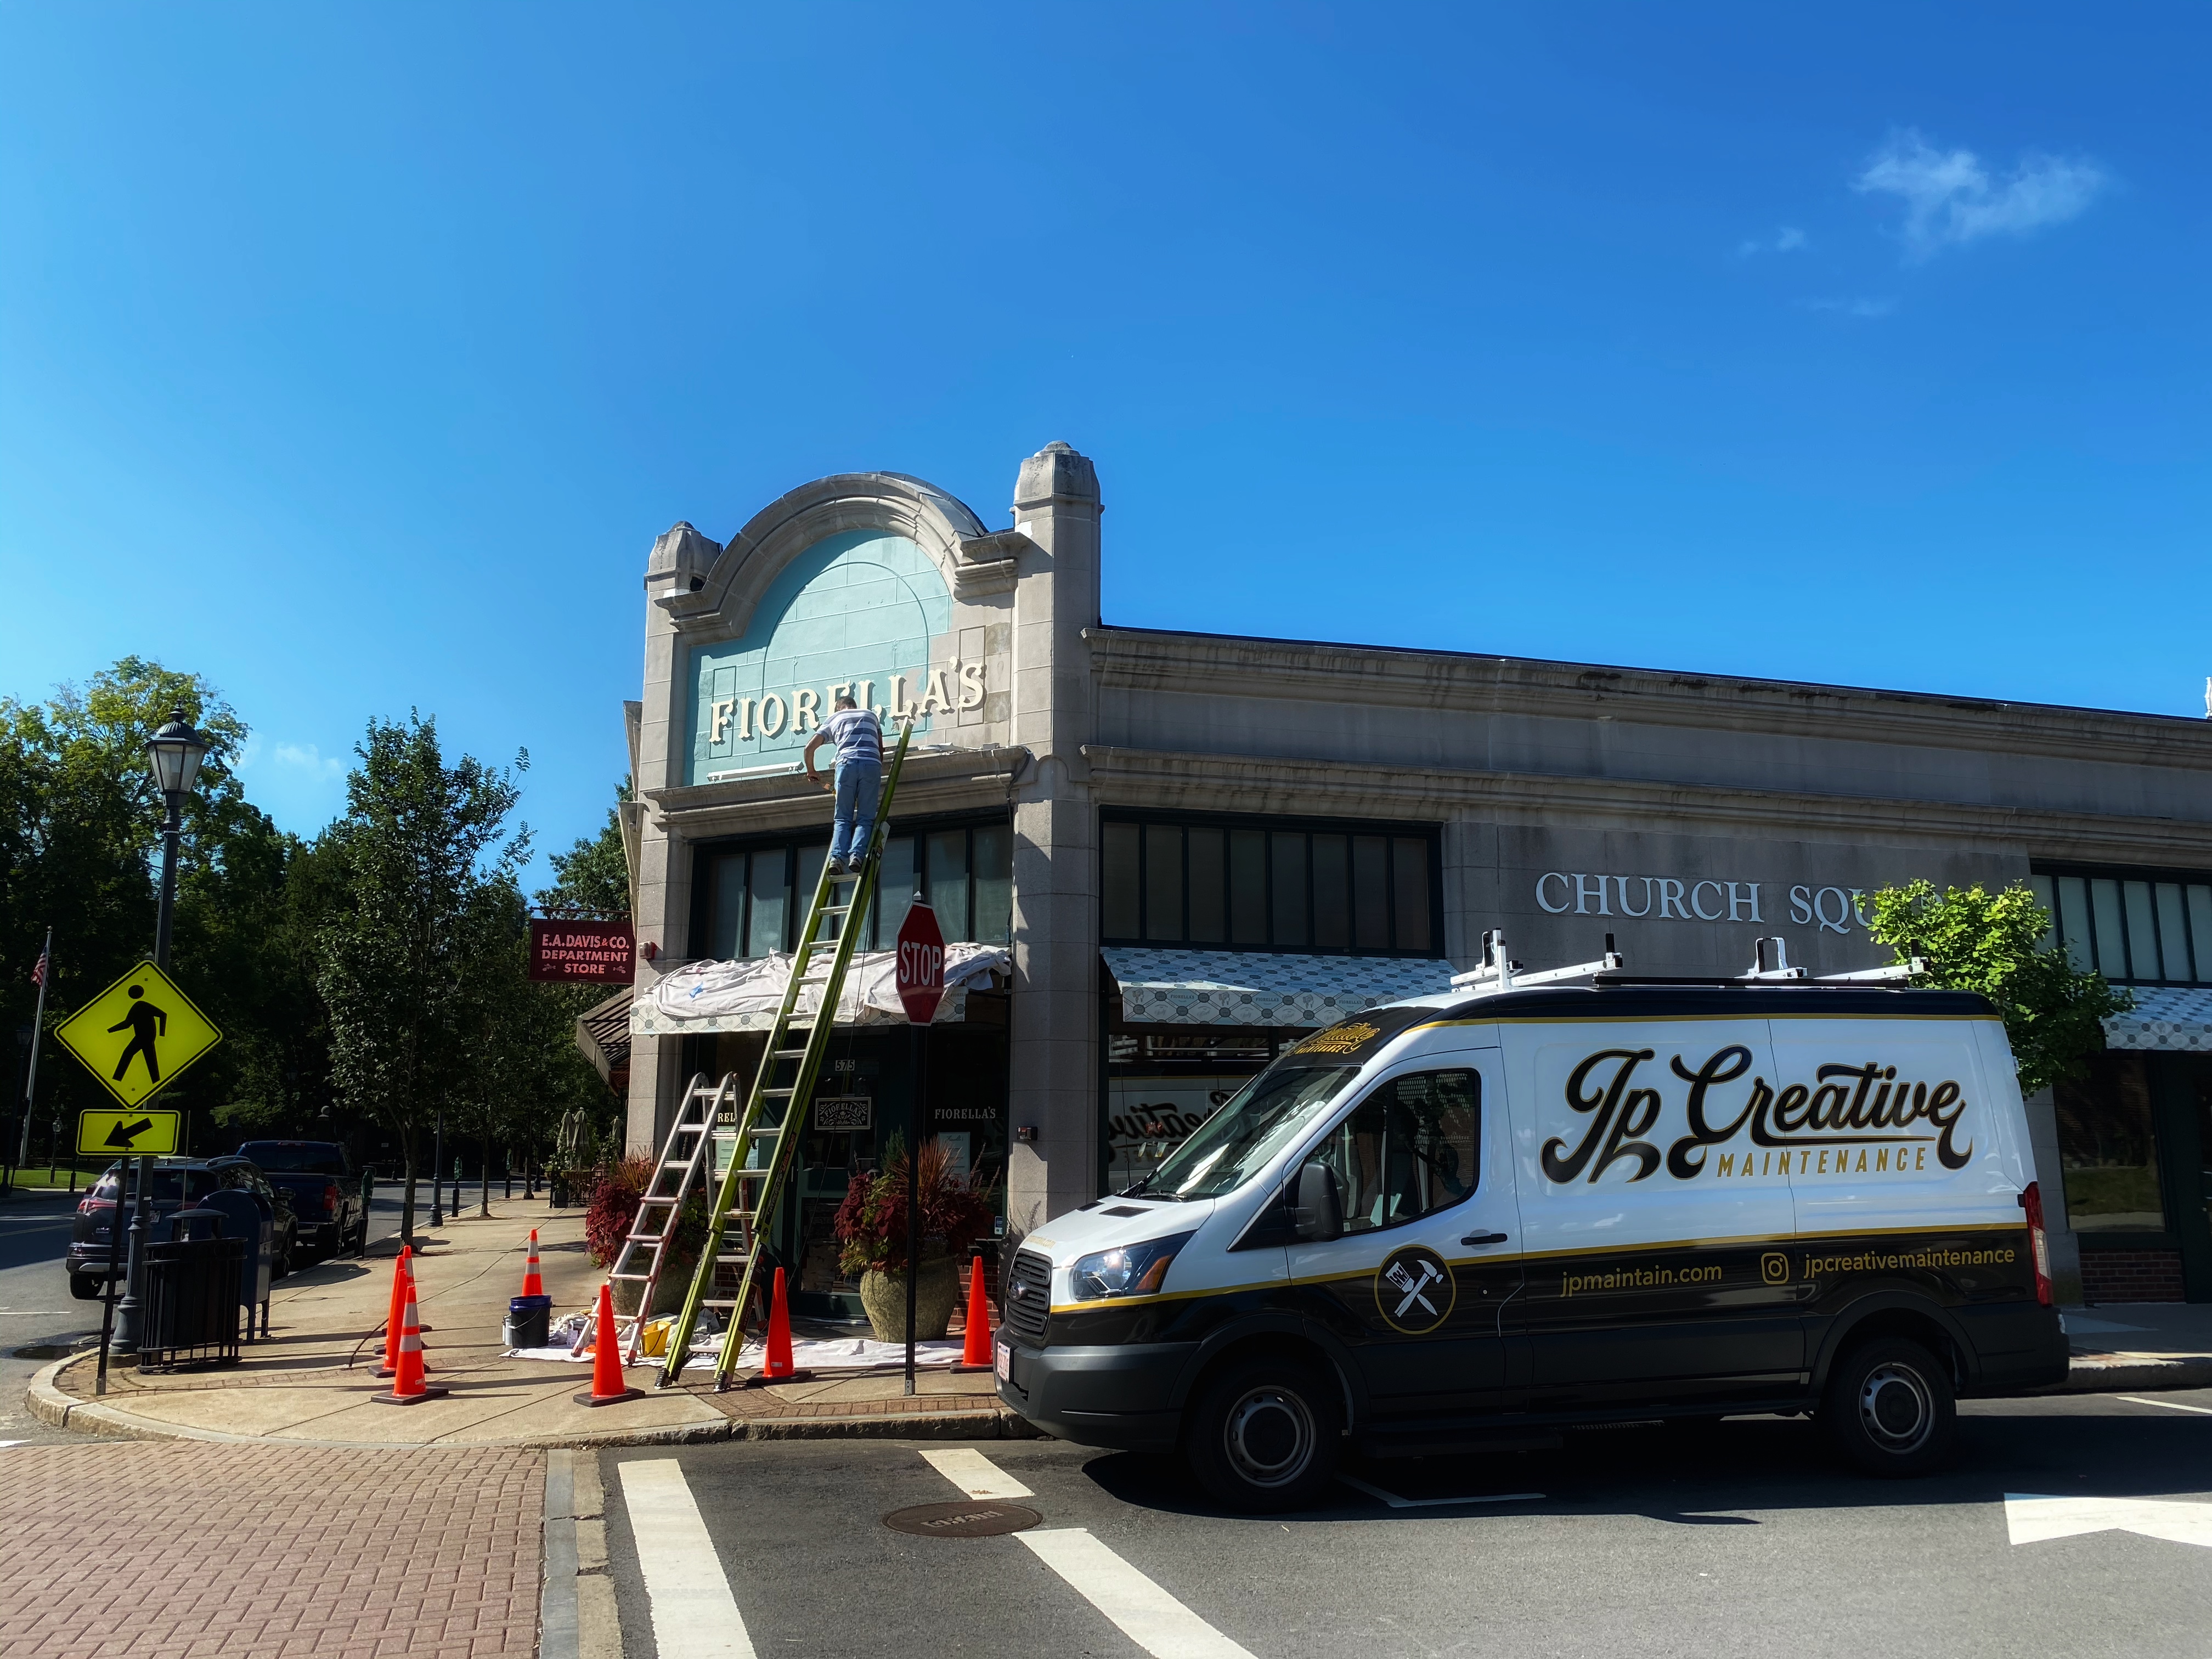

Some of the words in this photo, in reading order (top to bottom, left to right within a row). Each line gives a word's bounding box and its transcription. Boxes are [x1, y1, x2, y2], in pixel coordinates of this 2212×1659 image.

[1536, 872, 1765, 923] CHURCH
[1789, 884, 1879, 934] SQU
[541, 949, 629, 962] DEPARTMENT
[566, 934, 601, 949] DAVIS
[609, 936, 630, 949] CO.
[563, 963, 606, 974] STORE
[899, 940, 943, 987] STOP
[836, 1060, 854, 1070] 575
[934, 1105, 996, 1120] FIORELLA'S
[1666, 1044, 1973, 1181] Creative
[1717, 1147, 1926, 1178] MAINTENANCE
[1804, 1247, 2016, 1279] jpcreativemaintenance
[1560, 1262, 1723, 1298] jpmaintain.com
